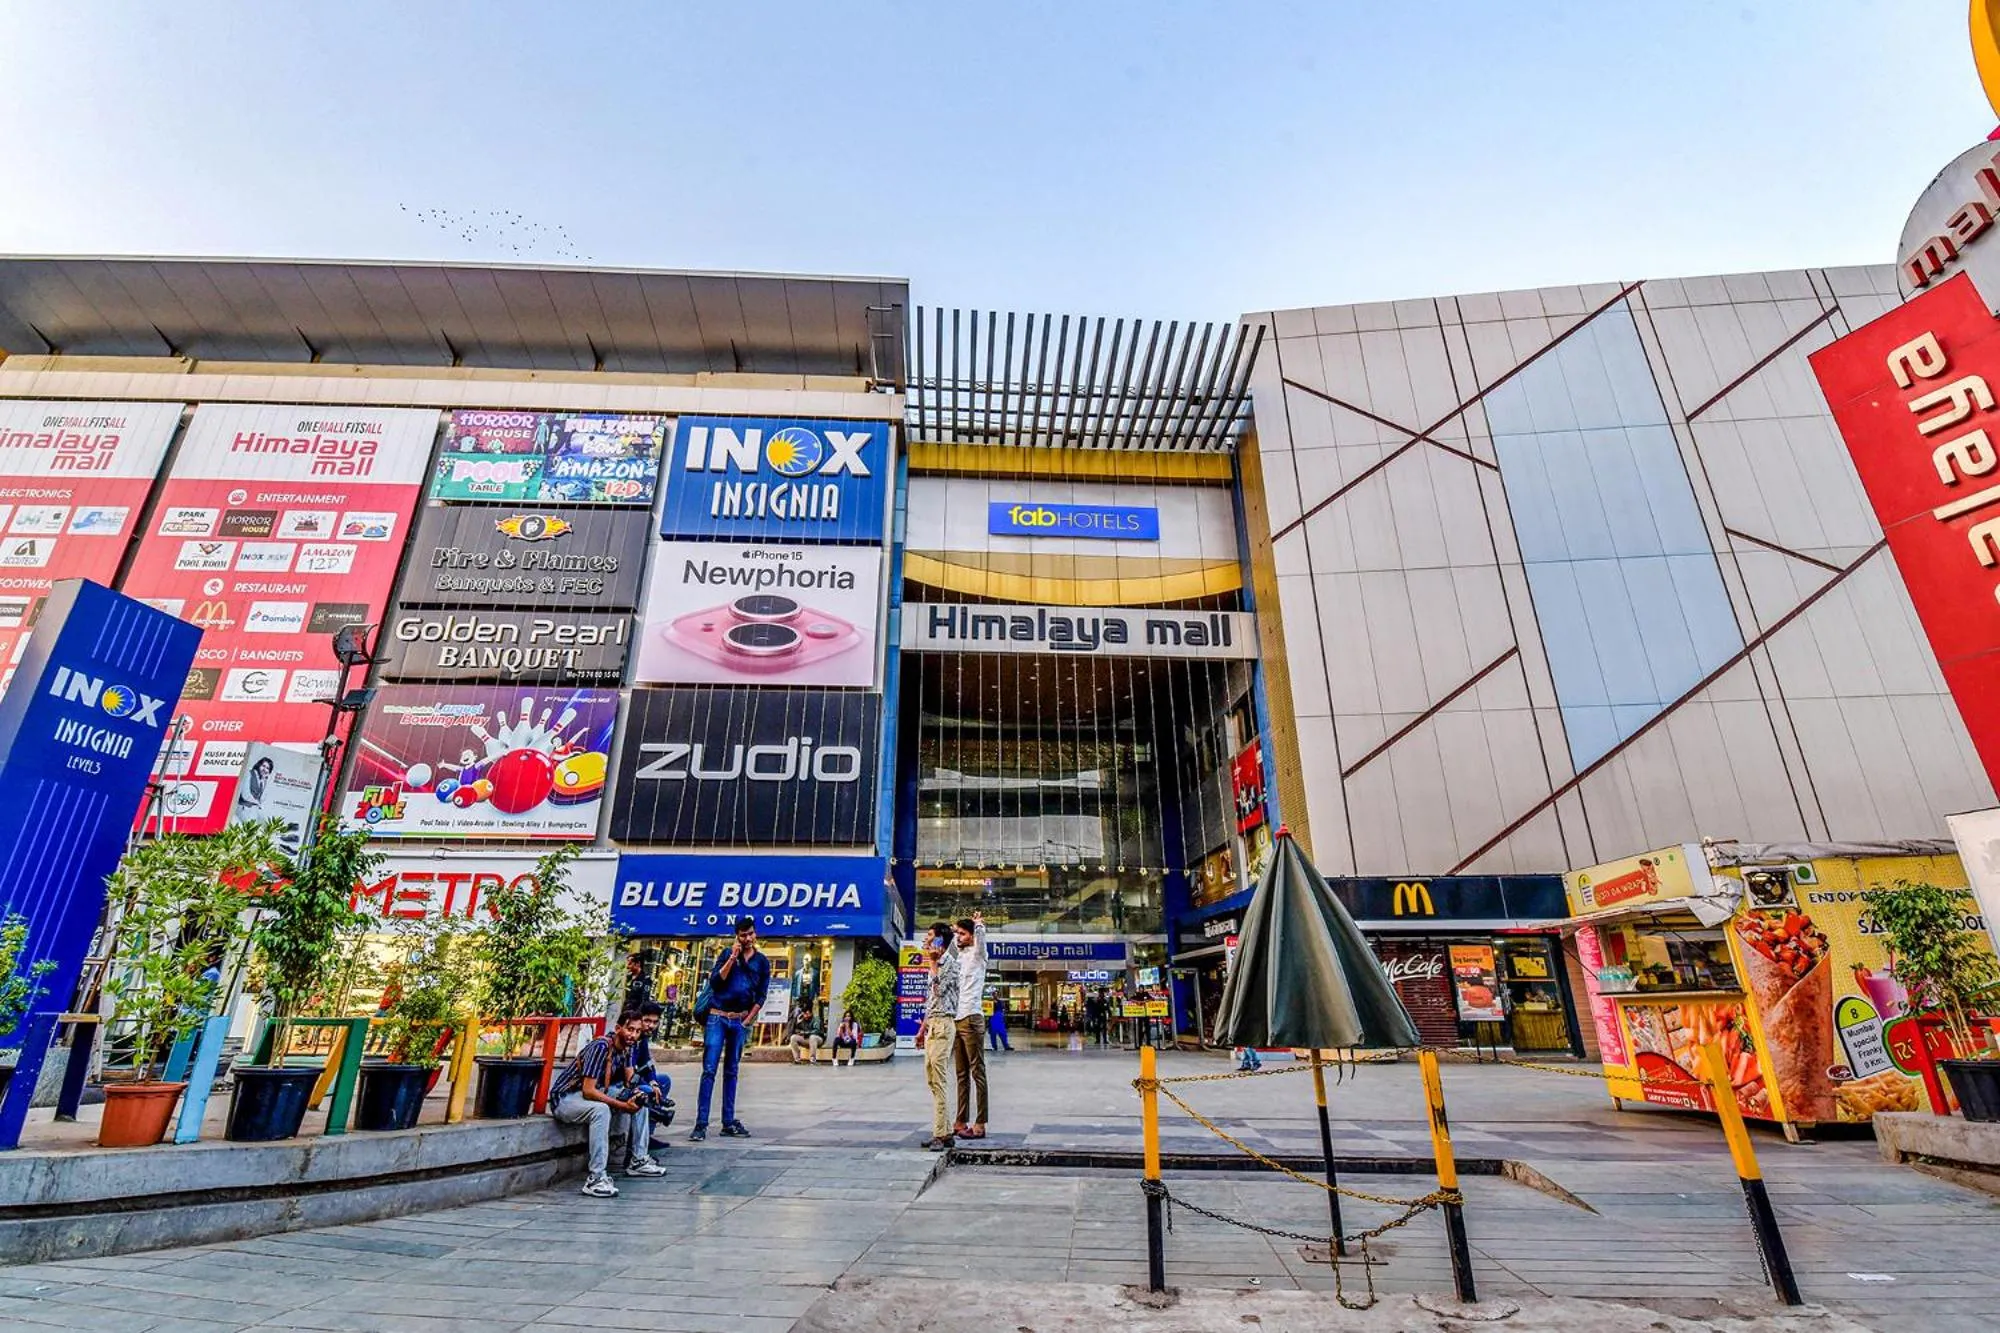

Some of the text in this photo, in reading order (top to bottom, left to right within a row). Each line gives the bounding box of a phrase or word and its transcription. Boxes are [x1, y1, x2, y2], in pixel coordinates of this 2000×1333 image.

[297, 421, 382, 435] ONEMALLFITSALL
[460, 413, 534, 428] HORROR
[0, 428, 120, 454] imalaya
[482, 429, 531, 438] HOUSE
[231, 432, 378, 459] Himalaya
[686, 426, 870, 477] INOX
[50, 451, 114, 470] mall
[311, 457, 373, 476] mall
[556, 461, 644, 479] AMAZON
[452, 461, 523, 483] POOL
[1887, 330, 2000, 612] alaya
[0, 488, 72, 499] ELECTRONICS
[256, 493, 347, 504] ENTERTAINMENT
[711, 481, 839, 520] INSIGNIA
[1009, 506, 1140, 531] fabHOTELS
[431, 548, 618, 571] Fire & Flames
[751, 551, 802, 560] iPhone 15
[0, 577, 53, 590] OOTWEA
[436, 575, 603, 594] Banquets & FEC
[683, 560, 855, 591] Newphoria
[234, 583, 308, 594] RESTAURANT
[396, 616, 625, 645] Golden Pearl
[929, 606, 1232, 650] Himalaya mall
[239, 651, 304, 661] BANQUETS
[438, 647, 581, 673] BANQUET
[49, 666, 165, 727] INOX
[203, 720, 243, 732] OTHER
[54, 718, 133, 759] INSIGNIA
[363, 782, 402, 807] FUN
[354, 801, 407, 824] ZONE
[619, 881, 861, 908] BLUE BUDDHA
[1809, 892, 1853, 903] ENJOY
[993, 944, 1093, 959] himalaya mall
[1850, 1008, 1858, 1018] 8
